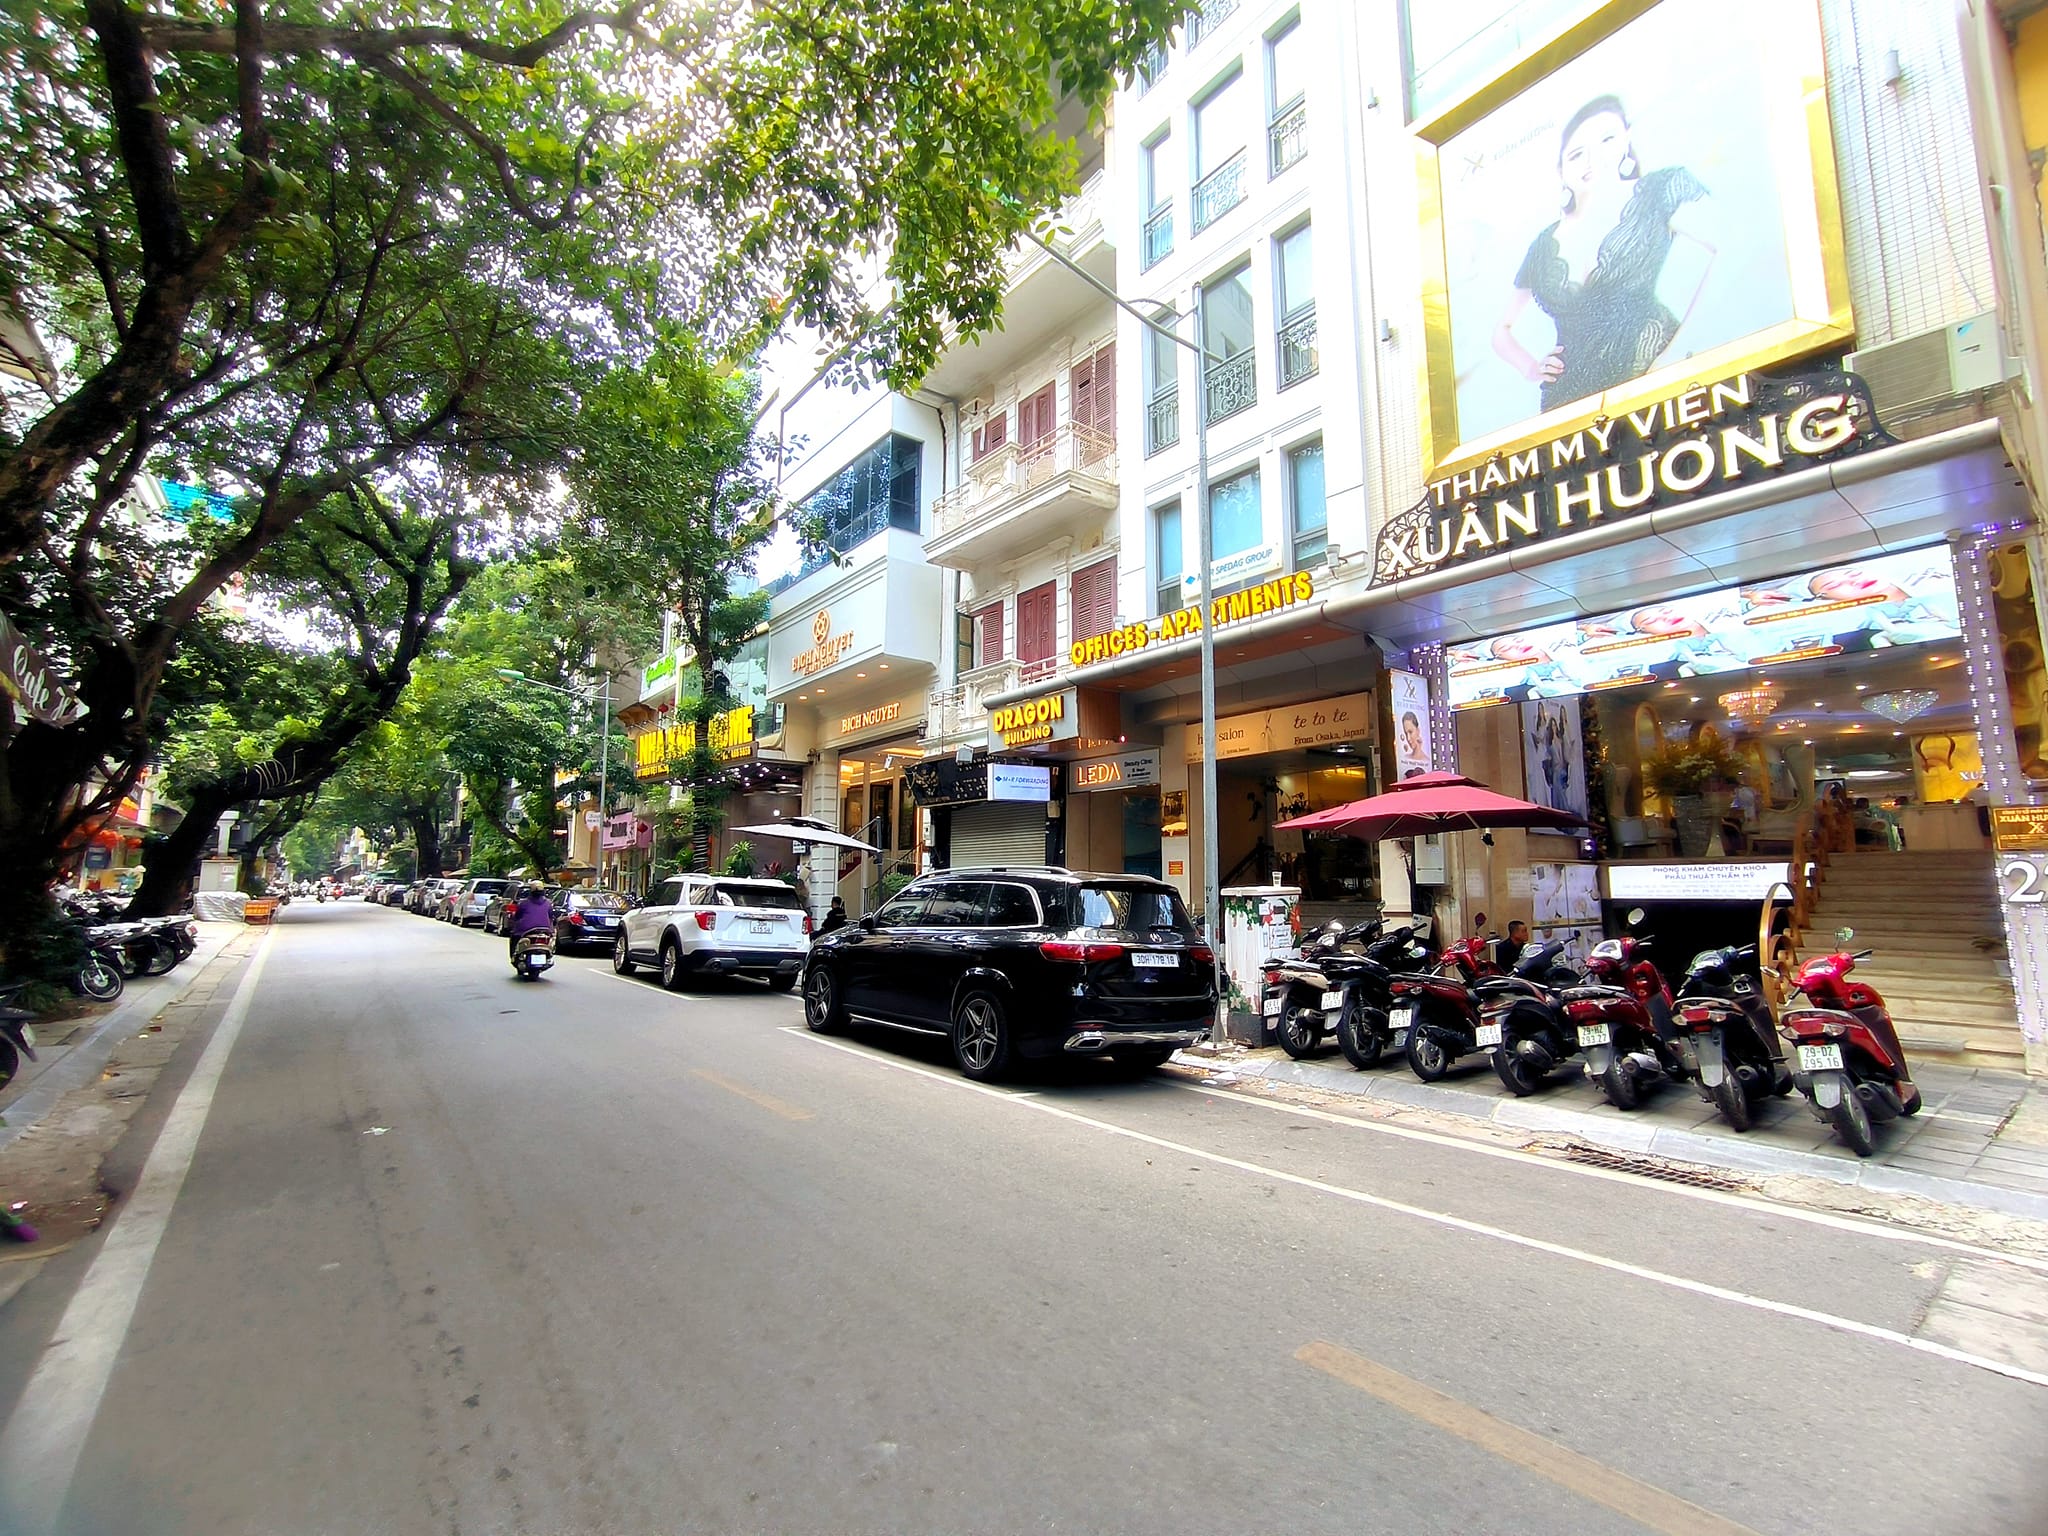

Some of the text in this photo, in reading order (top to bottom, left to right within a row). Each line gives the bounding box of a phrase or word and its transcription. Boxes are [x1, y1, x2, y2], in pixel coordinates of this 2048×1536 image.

[1626, 371, 1751, 441] VIỆN
[1382, 393, 1859, 576] XUÂN HƯƠNG
[1245, 548, 1273, 565] GROUP
[1071, 622, 1149, 665] OFFICES
[1161, 571, 1313, 641] APARTMENTS
[993, 695, 1064, 733] DRAGON
[1004, 724, 1053, 746] BUILDING
[1218, 727, 1245, 742] salon
[1294, 736, 1314, 745] From
[1342, 728, 1365, 740] Japan
[1803, 1057, 1840, 1069] 295.16
